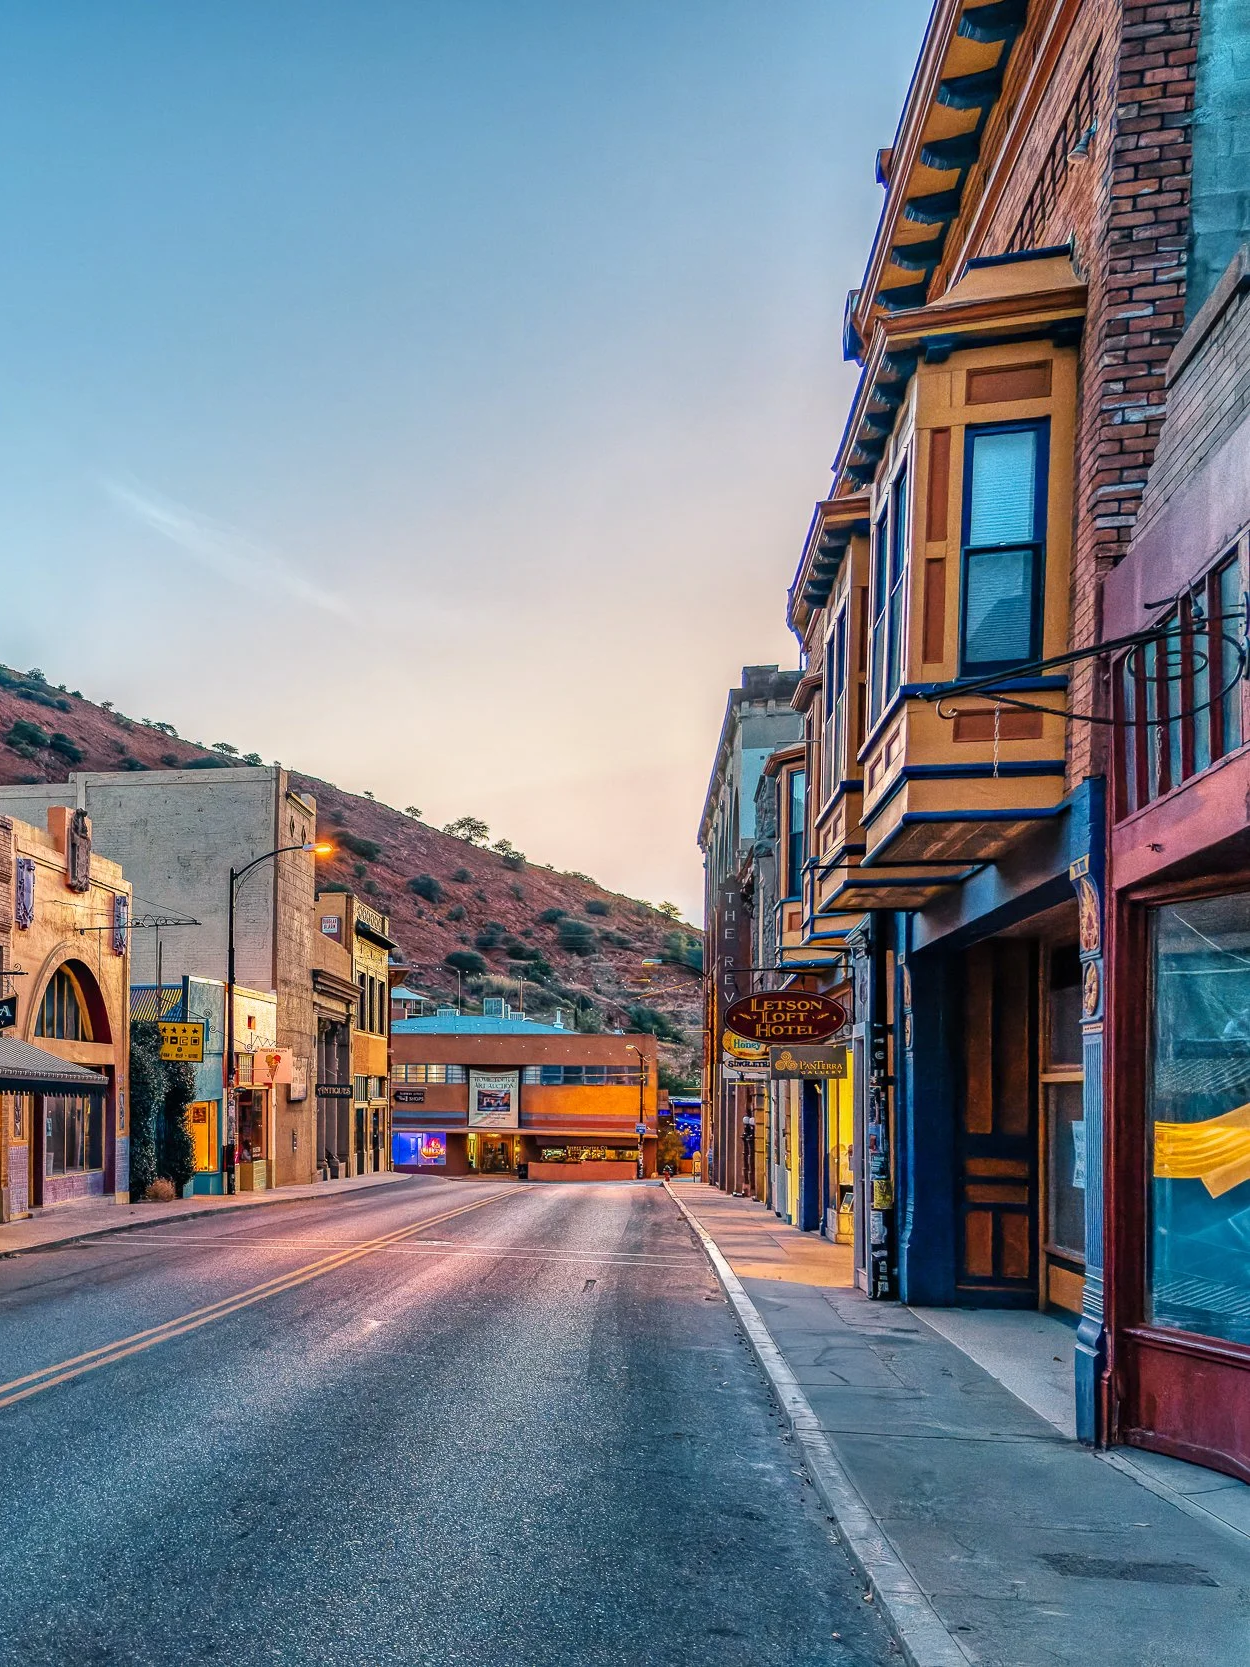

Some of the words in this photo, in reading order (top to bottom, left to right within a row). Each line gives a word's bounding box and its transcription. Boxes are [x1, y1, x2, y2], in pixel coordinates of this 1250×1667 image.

[724, 892, 735, 939] THE
[724, 956, 735, 1004] REV
[751, 998, 823, 1012] LETSON
[761, 1011, 808, 1024] LOFT
[755, 1023, 819, 1037] HOTEL
[733, 1038, 760, 1051] Honey
[317, 1085, 351, 1096] ANTIQUES
